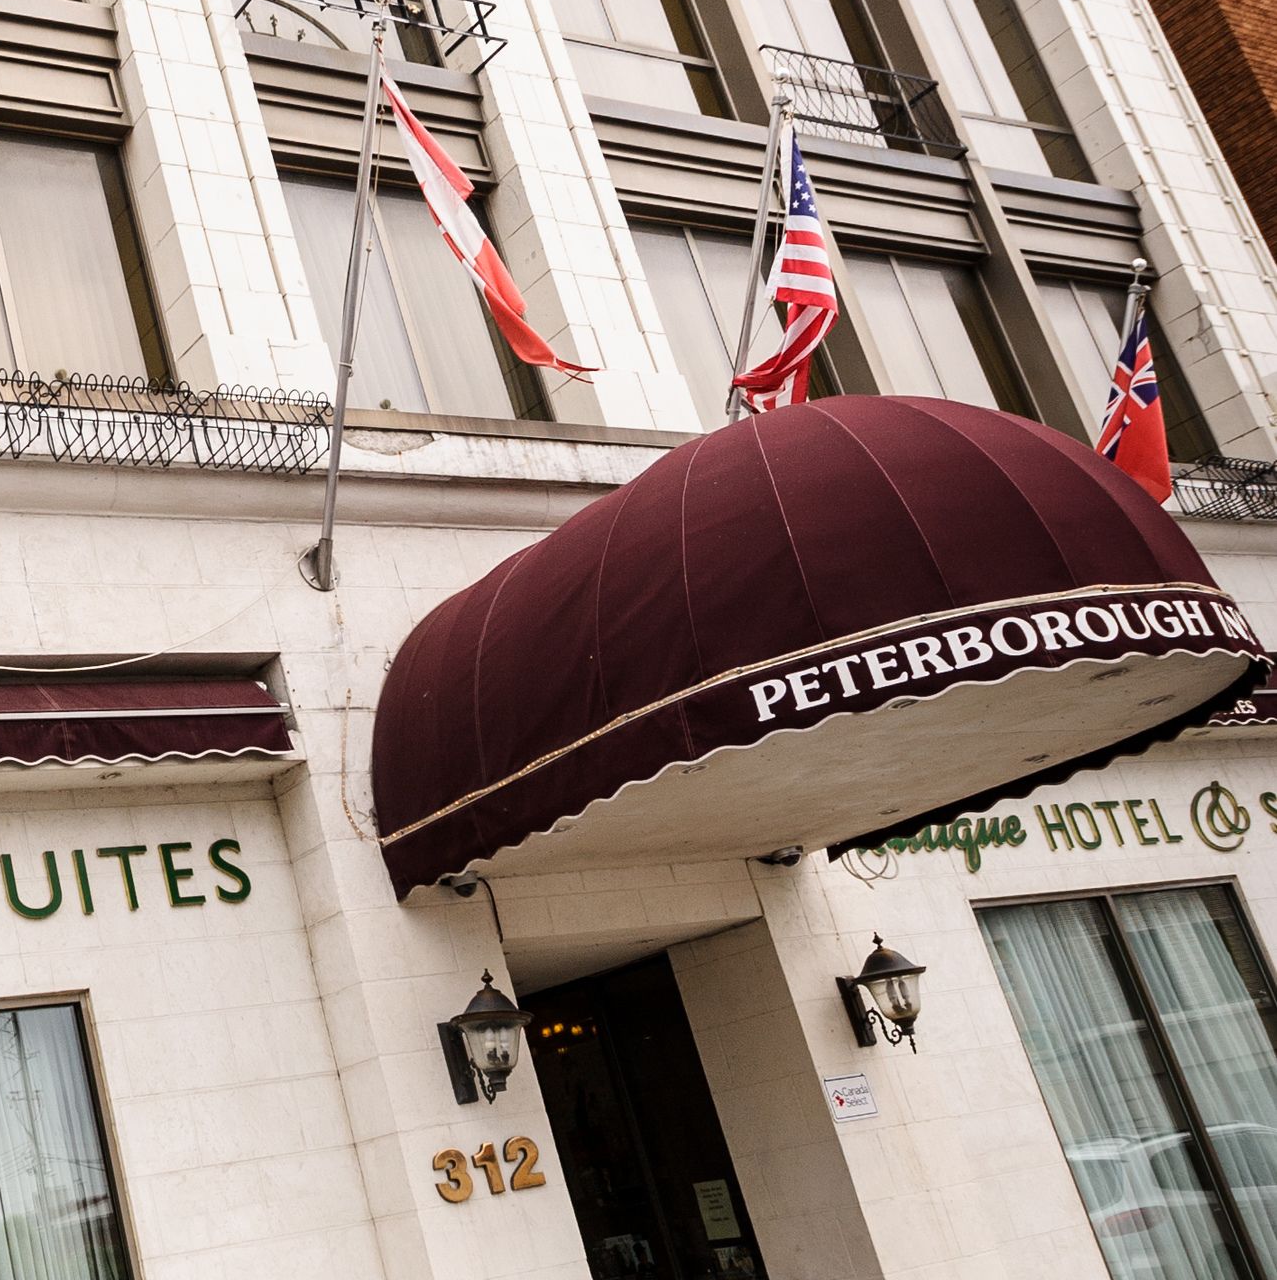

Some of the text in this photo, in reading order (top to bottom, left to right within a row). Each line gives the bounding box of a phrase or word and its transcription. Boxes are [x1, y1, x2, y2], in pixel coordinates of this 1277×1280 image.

[749, 599, 1215, 722] PETERBOROUGH
[1033, 797, 1184, 852] HOTEL
[1190, 780, 1251, 852] &
[841, 1084, 869, 1097] Canada
[433, 1135, 546, 1204] 312
